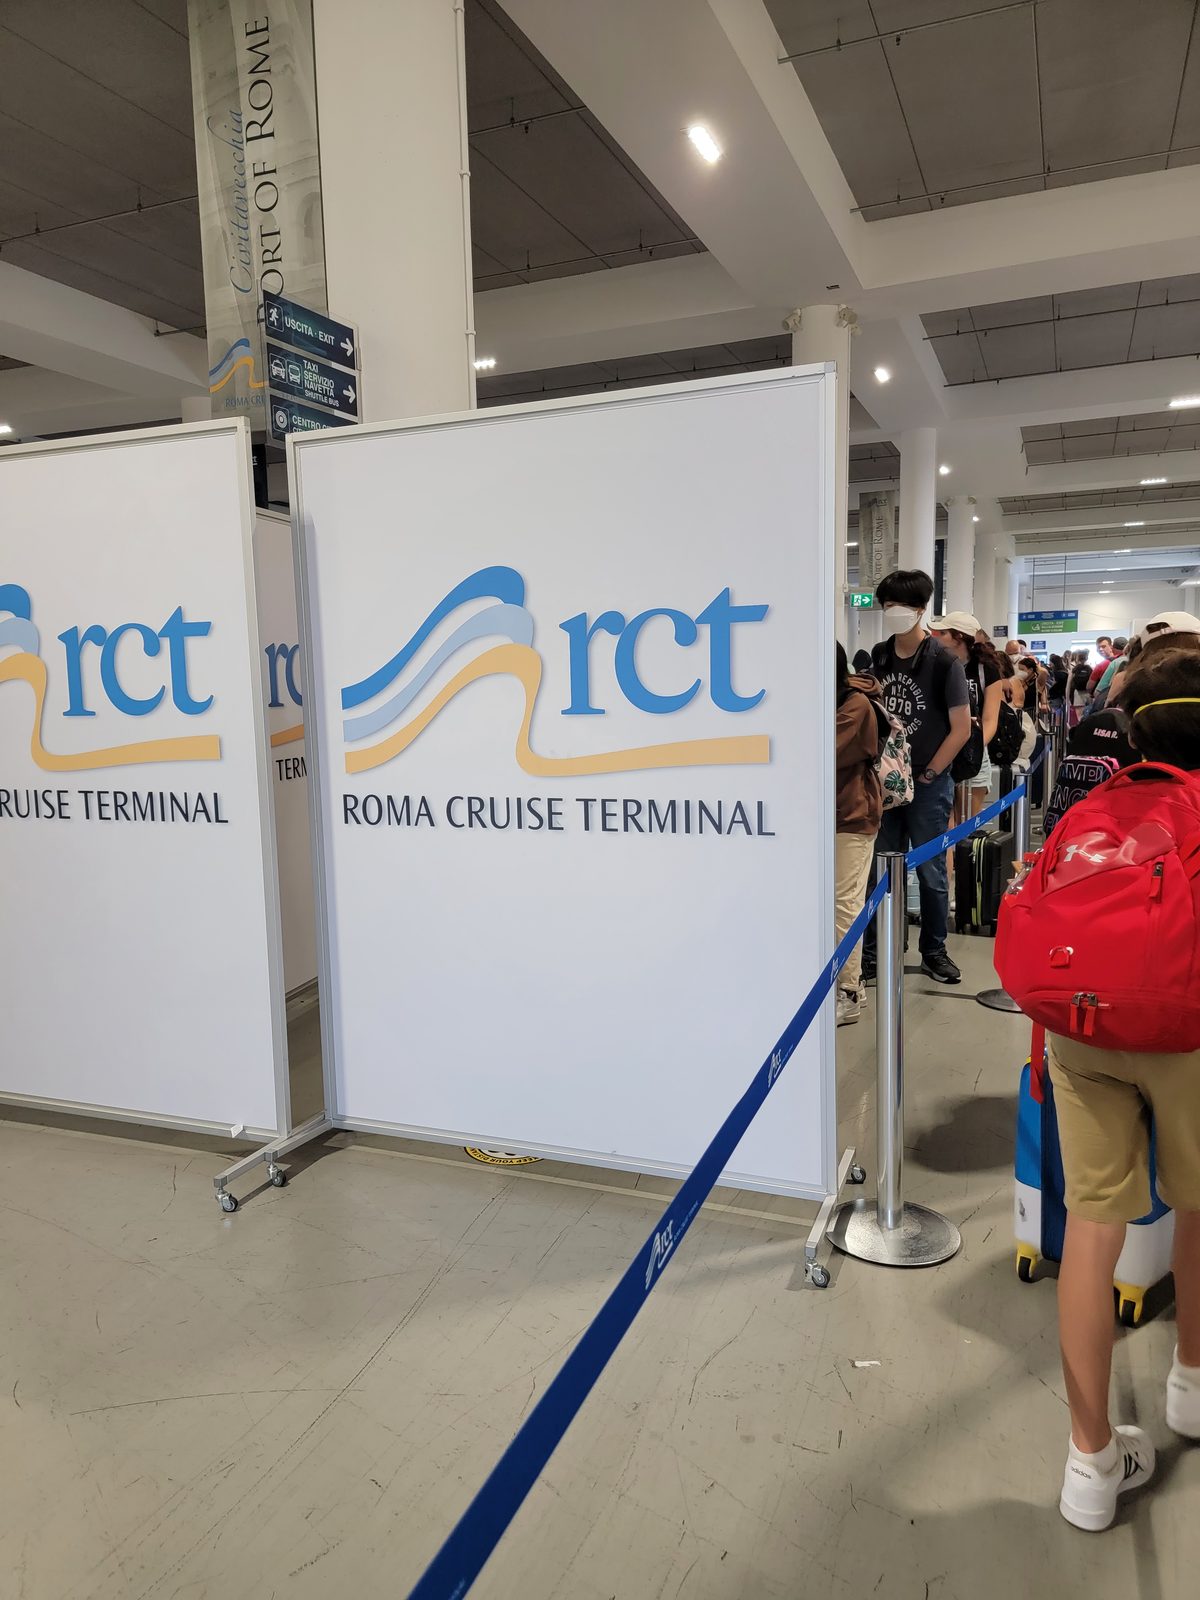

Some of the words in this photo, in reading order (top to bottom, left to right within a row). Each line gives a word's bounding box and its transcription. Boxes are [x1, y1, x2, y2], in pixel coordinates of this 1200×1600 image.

[245, 16, 275, 146] ROME
[207, 110, 252, 293] Civitavecchia
[252, 161, 279, 212] OF
[284, 316, 314, 337] USCITA
[318, 330, 335, 346] EXIT
[303, 360, 319, 374] TAXI
[303, 370, 335, 389] SERVIZIO
[304, 380, 335, 397] NAVETTA
[304, 389, 328, 404] SHUTTLE
[328, 397, 340, 407] BUS
[292, 415, 321, 430] CENTRO
[872, 515, 883, 545] ROME
[57, 605, 214, 717] rct
[559, 586, 770, 715] rct
[885, 696, 912, 716] 1978
[898, 673, 926, 710] REPUBLIC
[1093, 728, 1112, 738] LISA
[77, 789, 229, 824] TERMINAL
[342, 793, 435, 828] ROMA
[445, 795, 565, 832] CRUISE
[575, 797, 776, 838] TERMINAL
[1071, 1466, 1091, 1479] adidas
